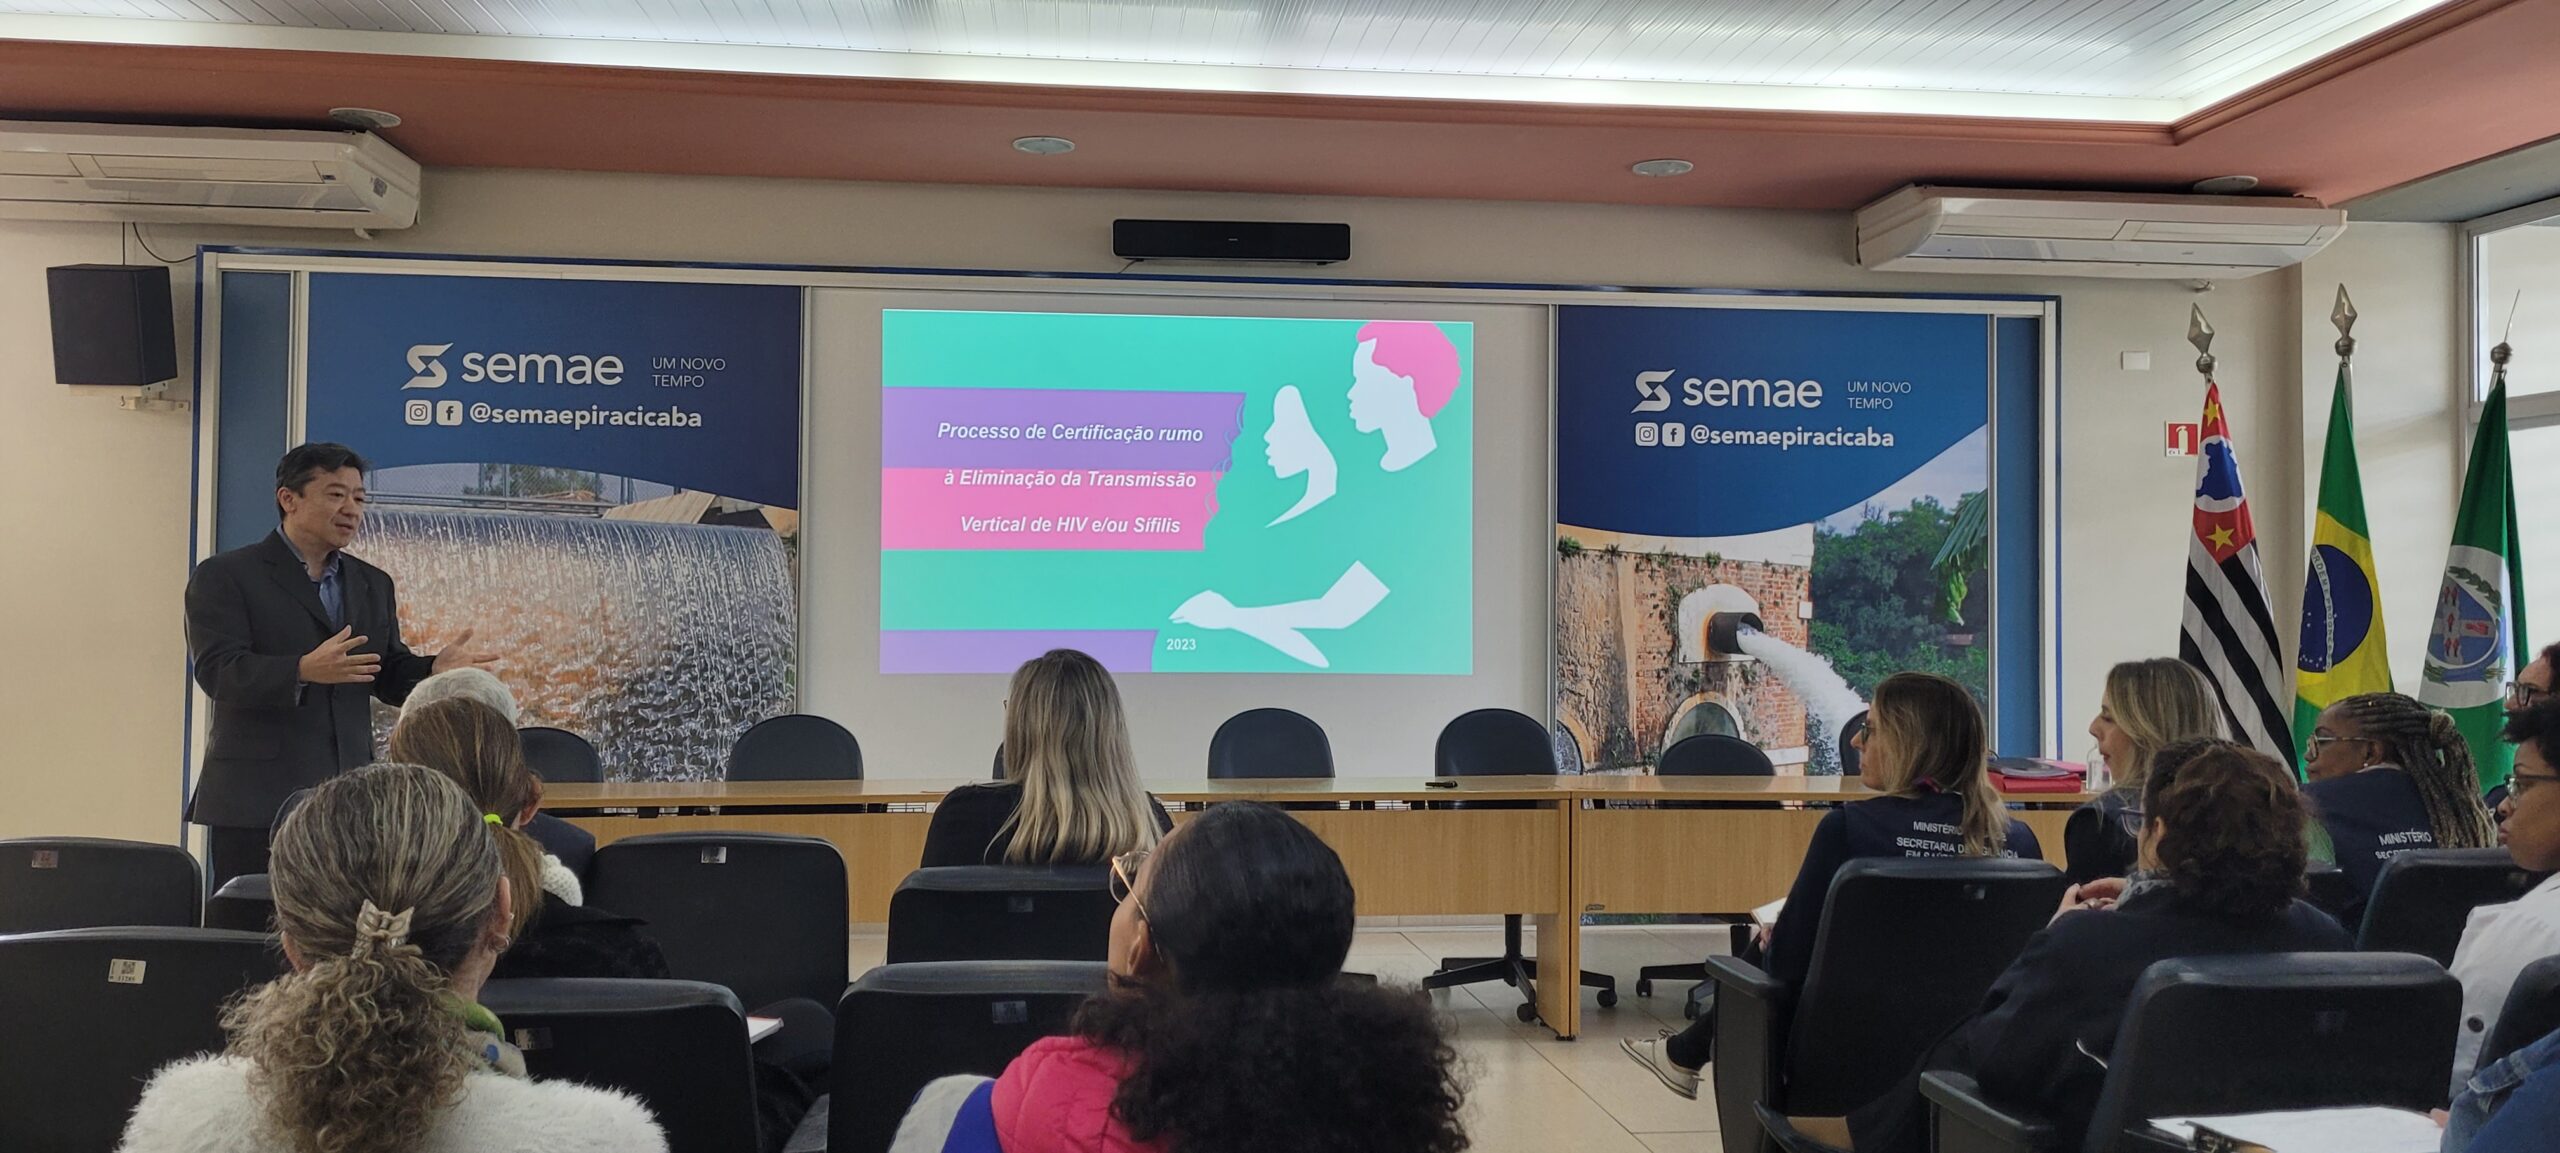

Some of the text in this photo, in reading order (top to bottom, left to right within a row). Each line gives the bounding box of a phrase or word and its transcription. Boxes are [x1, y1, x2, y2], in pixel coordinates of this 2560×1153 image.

[461, 352, 624, 386] semae
[652, 357, 726, 371] UM NOVO
[652, 374, 705, 388] TEMPO
[1847, 381, 1912, 394] UM NOVO
[1682, 377, 1823, 408] semae
[1848, 397, 1893, 410] TEMPO
[469, 402, 702, 430] @semaepiracicaba
[937, 422, 1204, 444] Processo de Certificação rumo
[1690, 424, 1895, 450] @semaepiracicaba
[944, 470, 1197, 489] à Eliminação da Transmissão
[961, 516, 1181, 533] Vertical de HIV e/ou Sífilis
[1166, 638, 1196, 650] 2023
[1896, 837, 1955, 853] SECRETARIA
[2379, 828, 2432, 846] MINISTÉRIO
